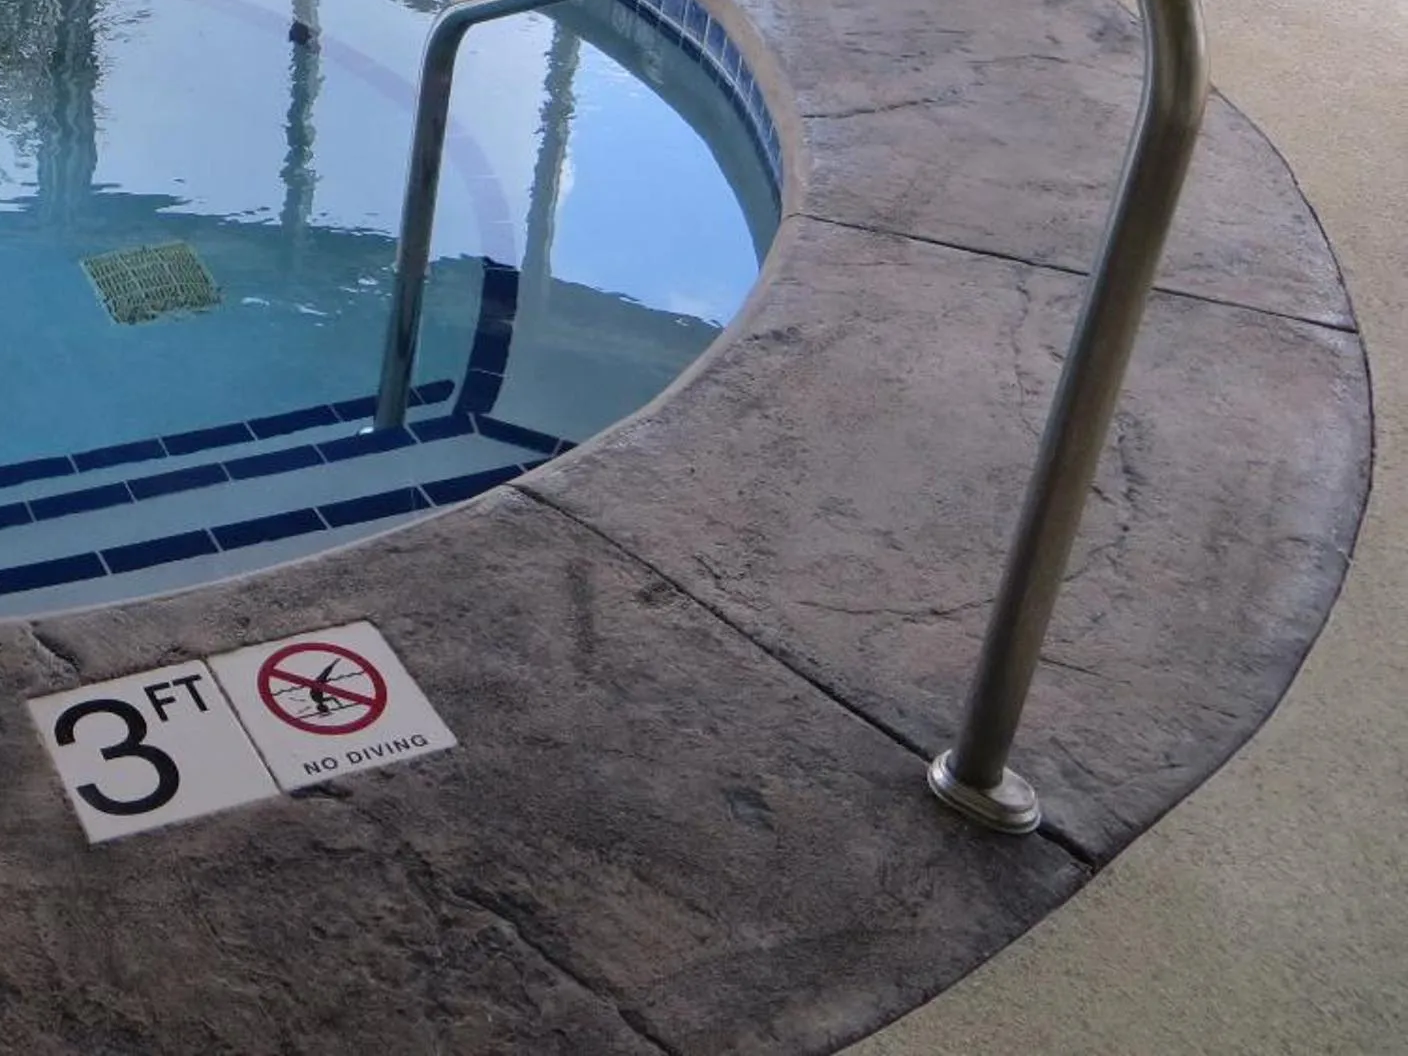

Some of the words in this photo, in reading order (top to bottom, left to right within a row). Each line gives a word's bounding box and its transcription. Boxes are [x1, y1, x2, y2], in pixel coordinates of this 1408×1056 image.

[53, 698, 181, 816] 3
[142, 674, 211, 722] FT
[303, 755, 340, 777] NO
[345, 733, 429, 766] DIVING
